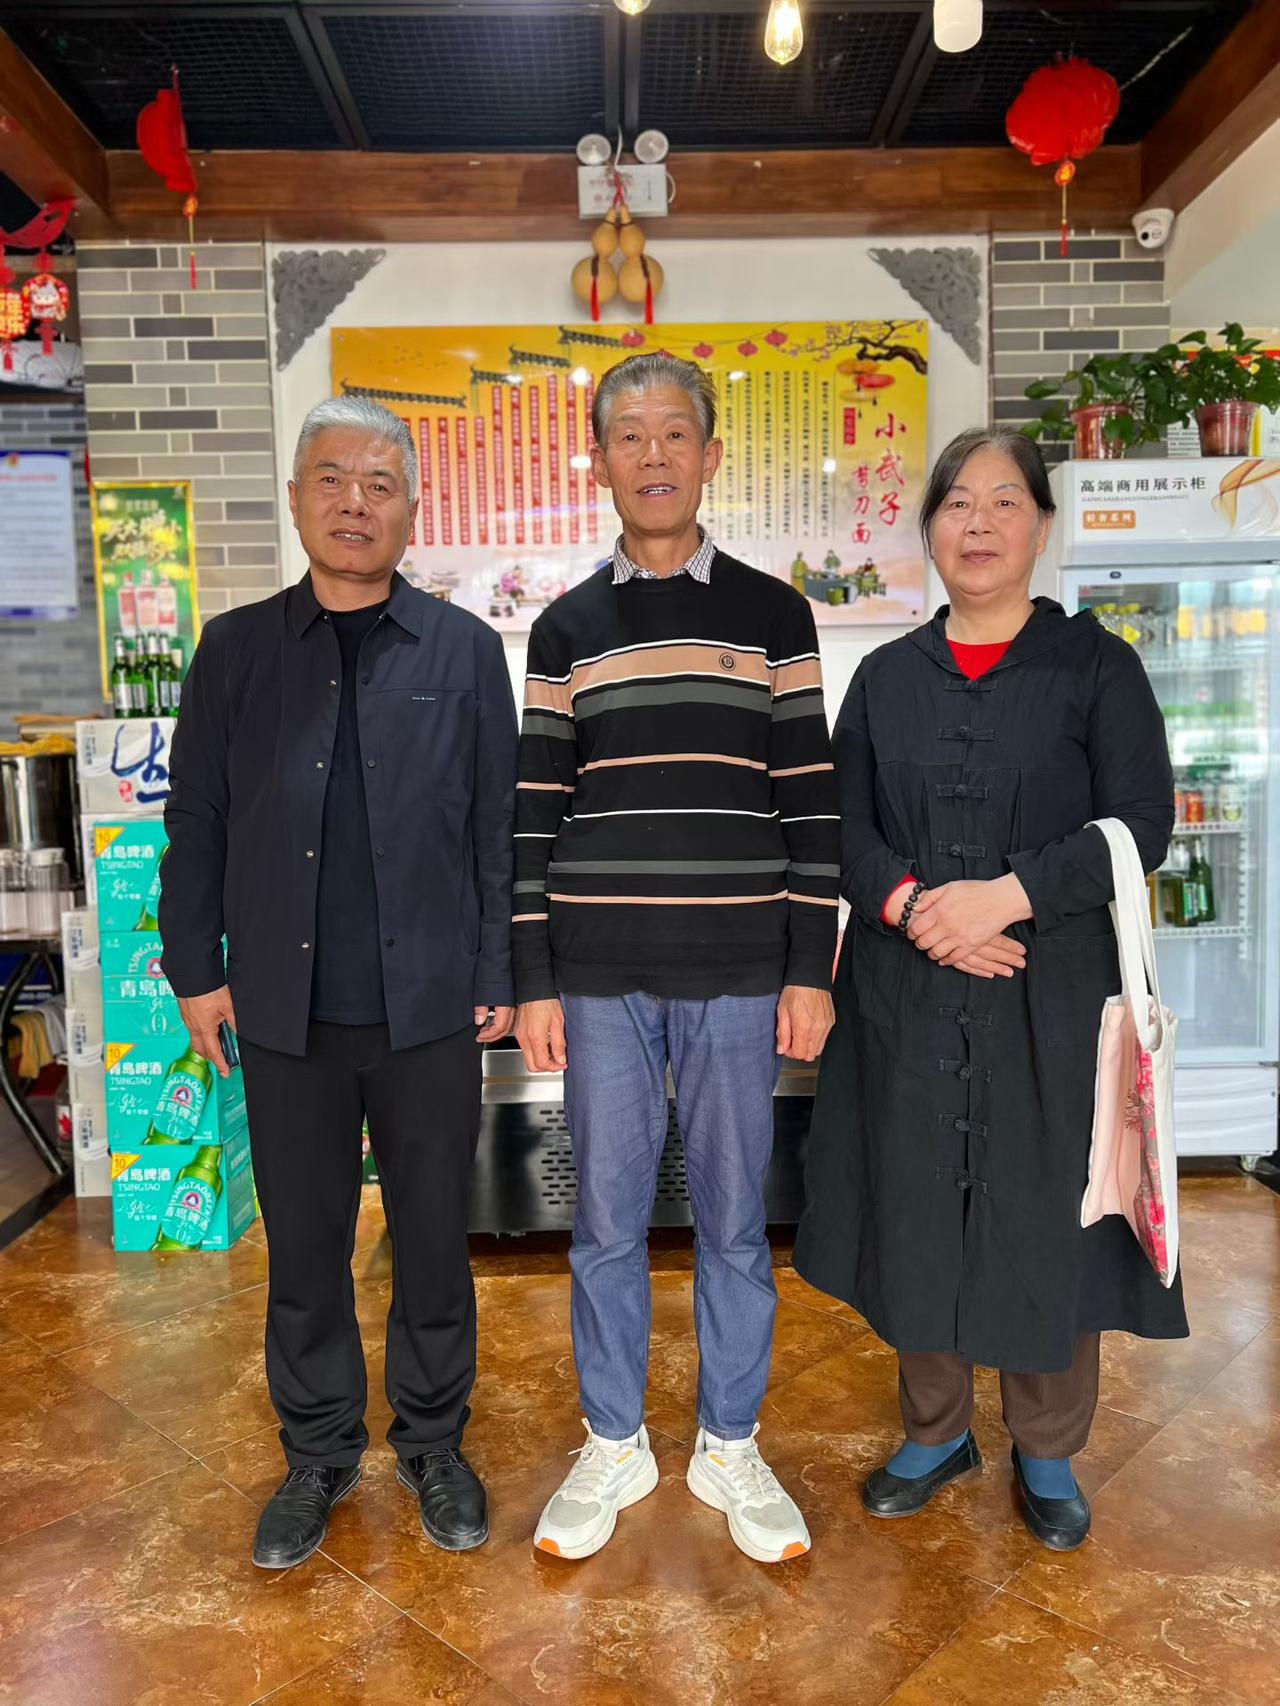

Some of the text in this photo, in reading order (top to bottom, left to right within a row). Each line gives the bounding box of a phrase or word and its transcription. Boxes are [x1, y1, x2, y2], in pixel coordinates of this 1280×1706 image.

[875, 412, 907, 526] 小武子
[1080, 476, 1206, 493] 高端商用展示柜
[109, 1047, 121, 1059] 10
[110, 1077, 152, 1086] TSINGTAO
[115, 1158, 126, 1169] 10
[118, 1183, 161, 1191] TSINGTAO
